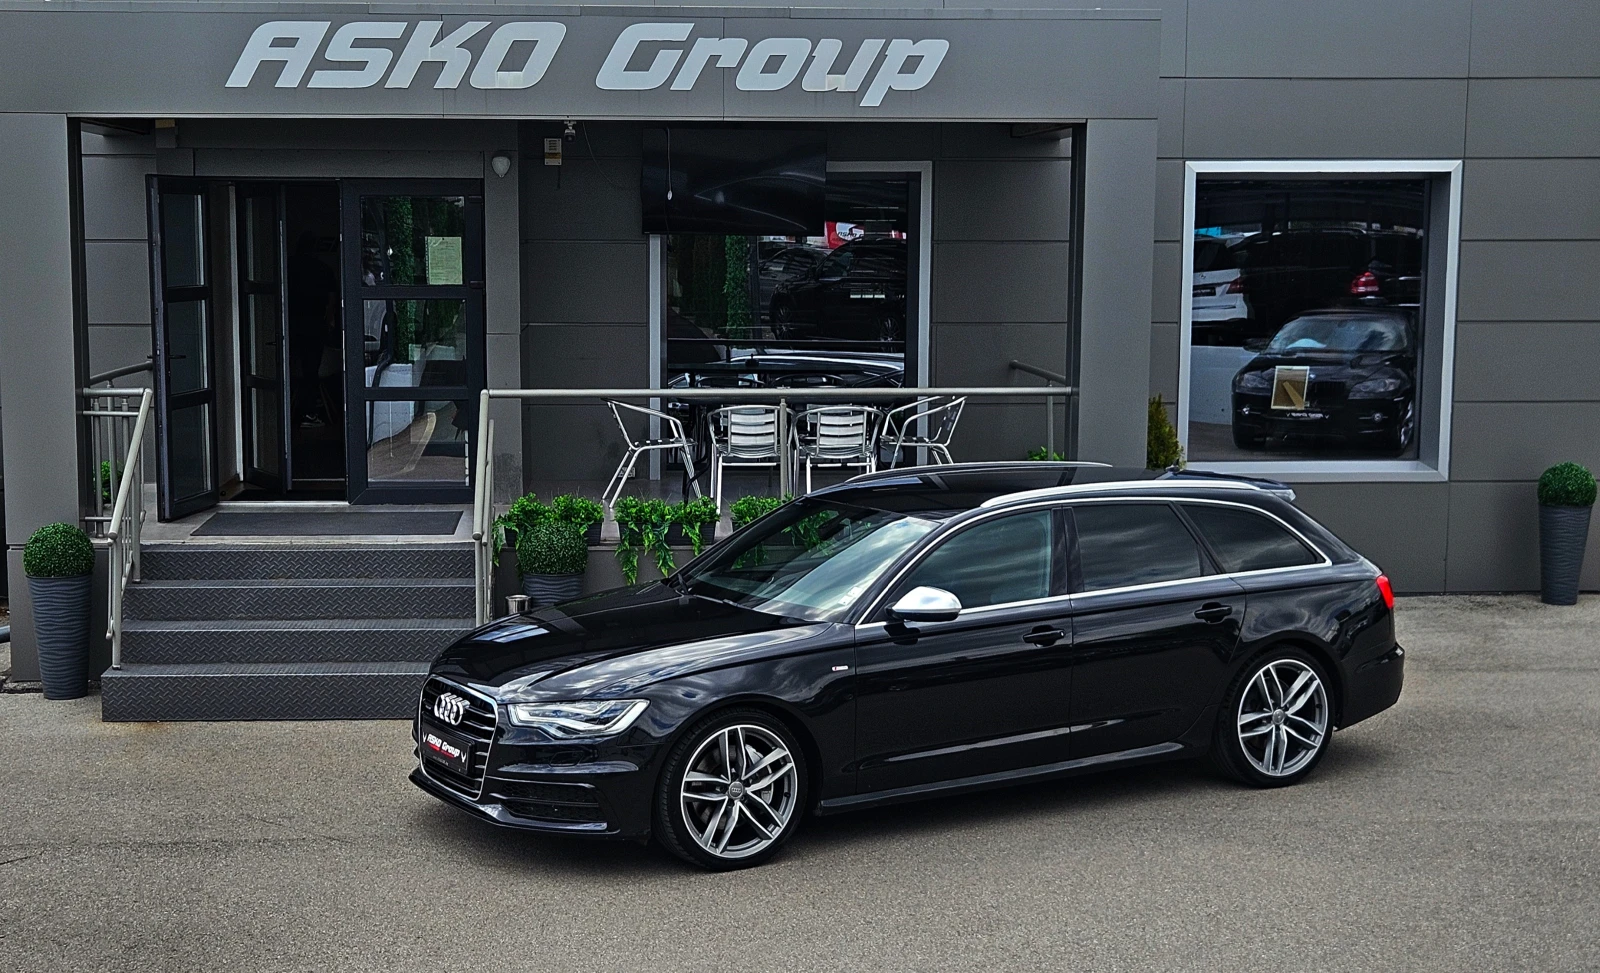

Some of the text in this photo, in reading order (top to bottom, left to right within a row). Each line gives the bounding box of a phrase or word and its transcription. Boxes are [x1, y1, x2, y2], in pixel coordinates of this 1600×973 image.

[225, 20, 950, 107] ASKO Group
[427, 733, 460, 757] ASKO Group
